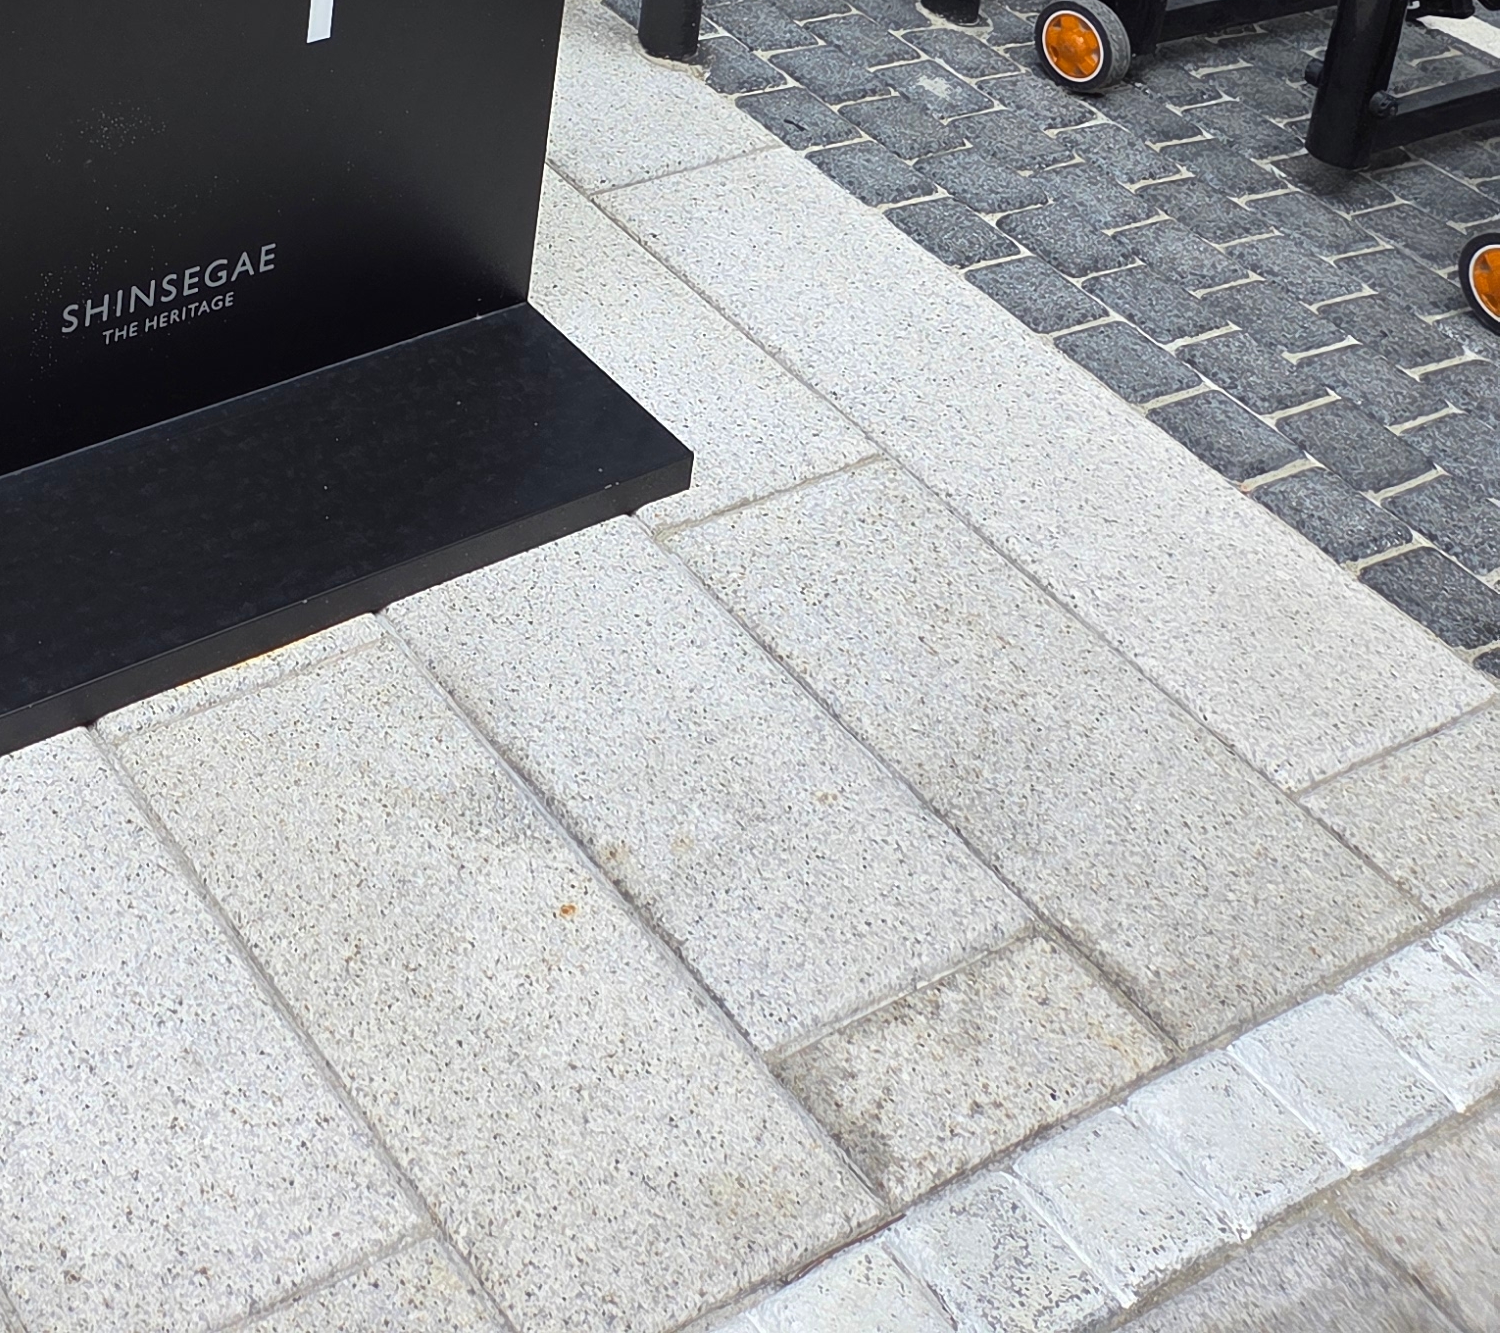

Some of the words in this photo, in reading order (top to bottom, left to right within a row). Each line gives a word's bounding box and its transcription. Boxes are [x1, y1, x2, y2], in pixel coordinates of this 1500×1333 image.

[61, 243, 277, 334] SHINSEGAE
[102, 321, 138, 345] THE
[144, 291, 235, 333] HERITAGE
